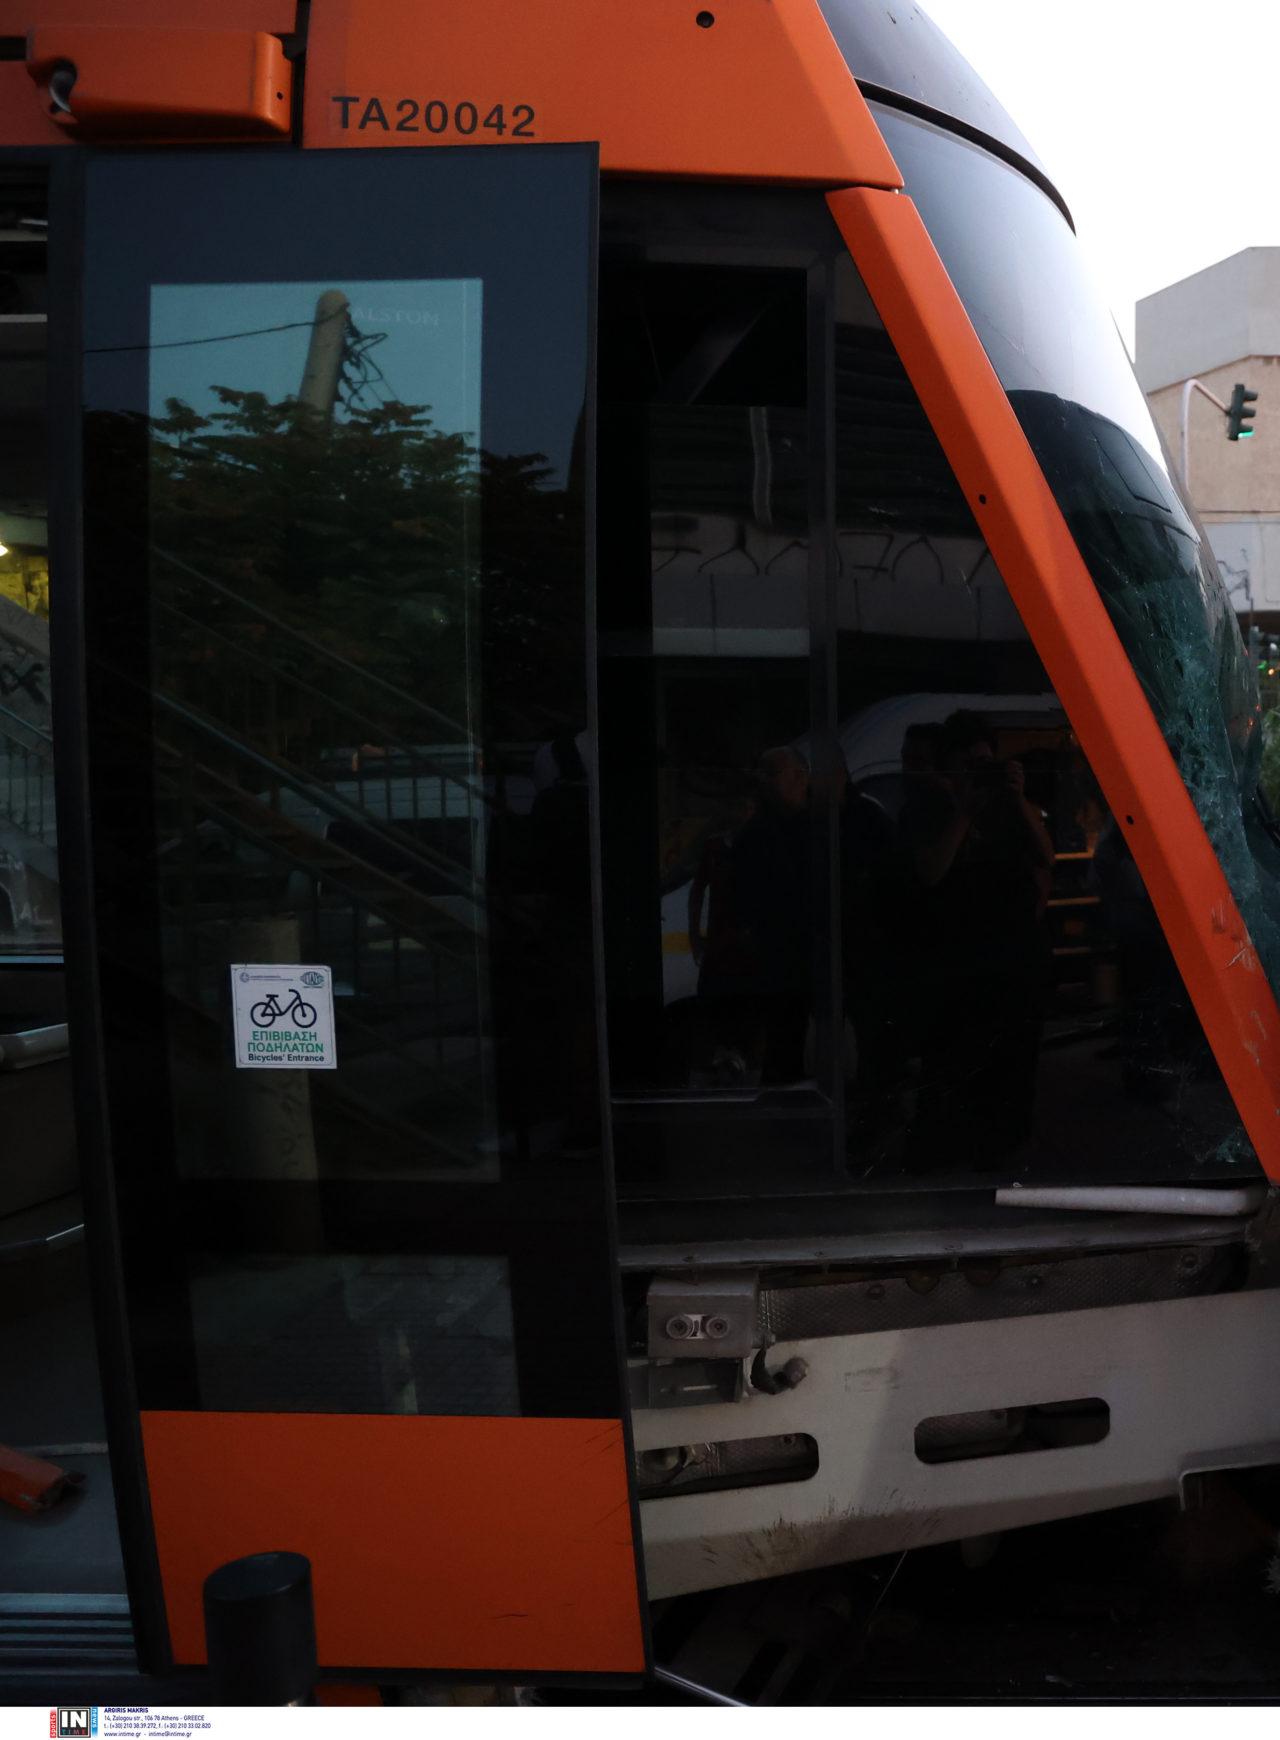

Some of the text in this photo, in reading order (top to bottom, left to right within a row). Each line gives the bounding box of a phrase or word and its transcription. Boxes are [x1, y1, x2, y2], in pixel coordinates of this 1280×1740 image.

[332, 96, 535, 137] TA20042
[252, 1030, 317, 1042] ΕΠΙΒΙΒΑΣΗ
[247, 1042, 324, 1053] ΠΟΔΗΛΑΤΩΝ
[248, 1053, 325, 1063] Bicycles' Entrance
